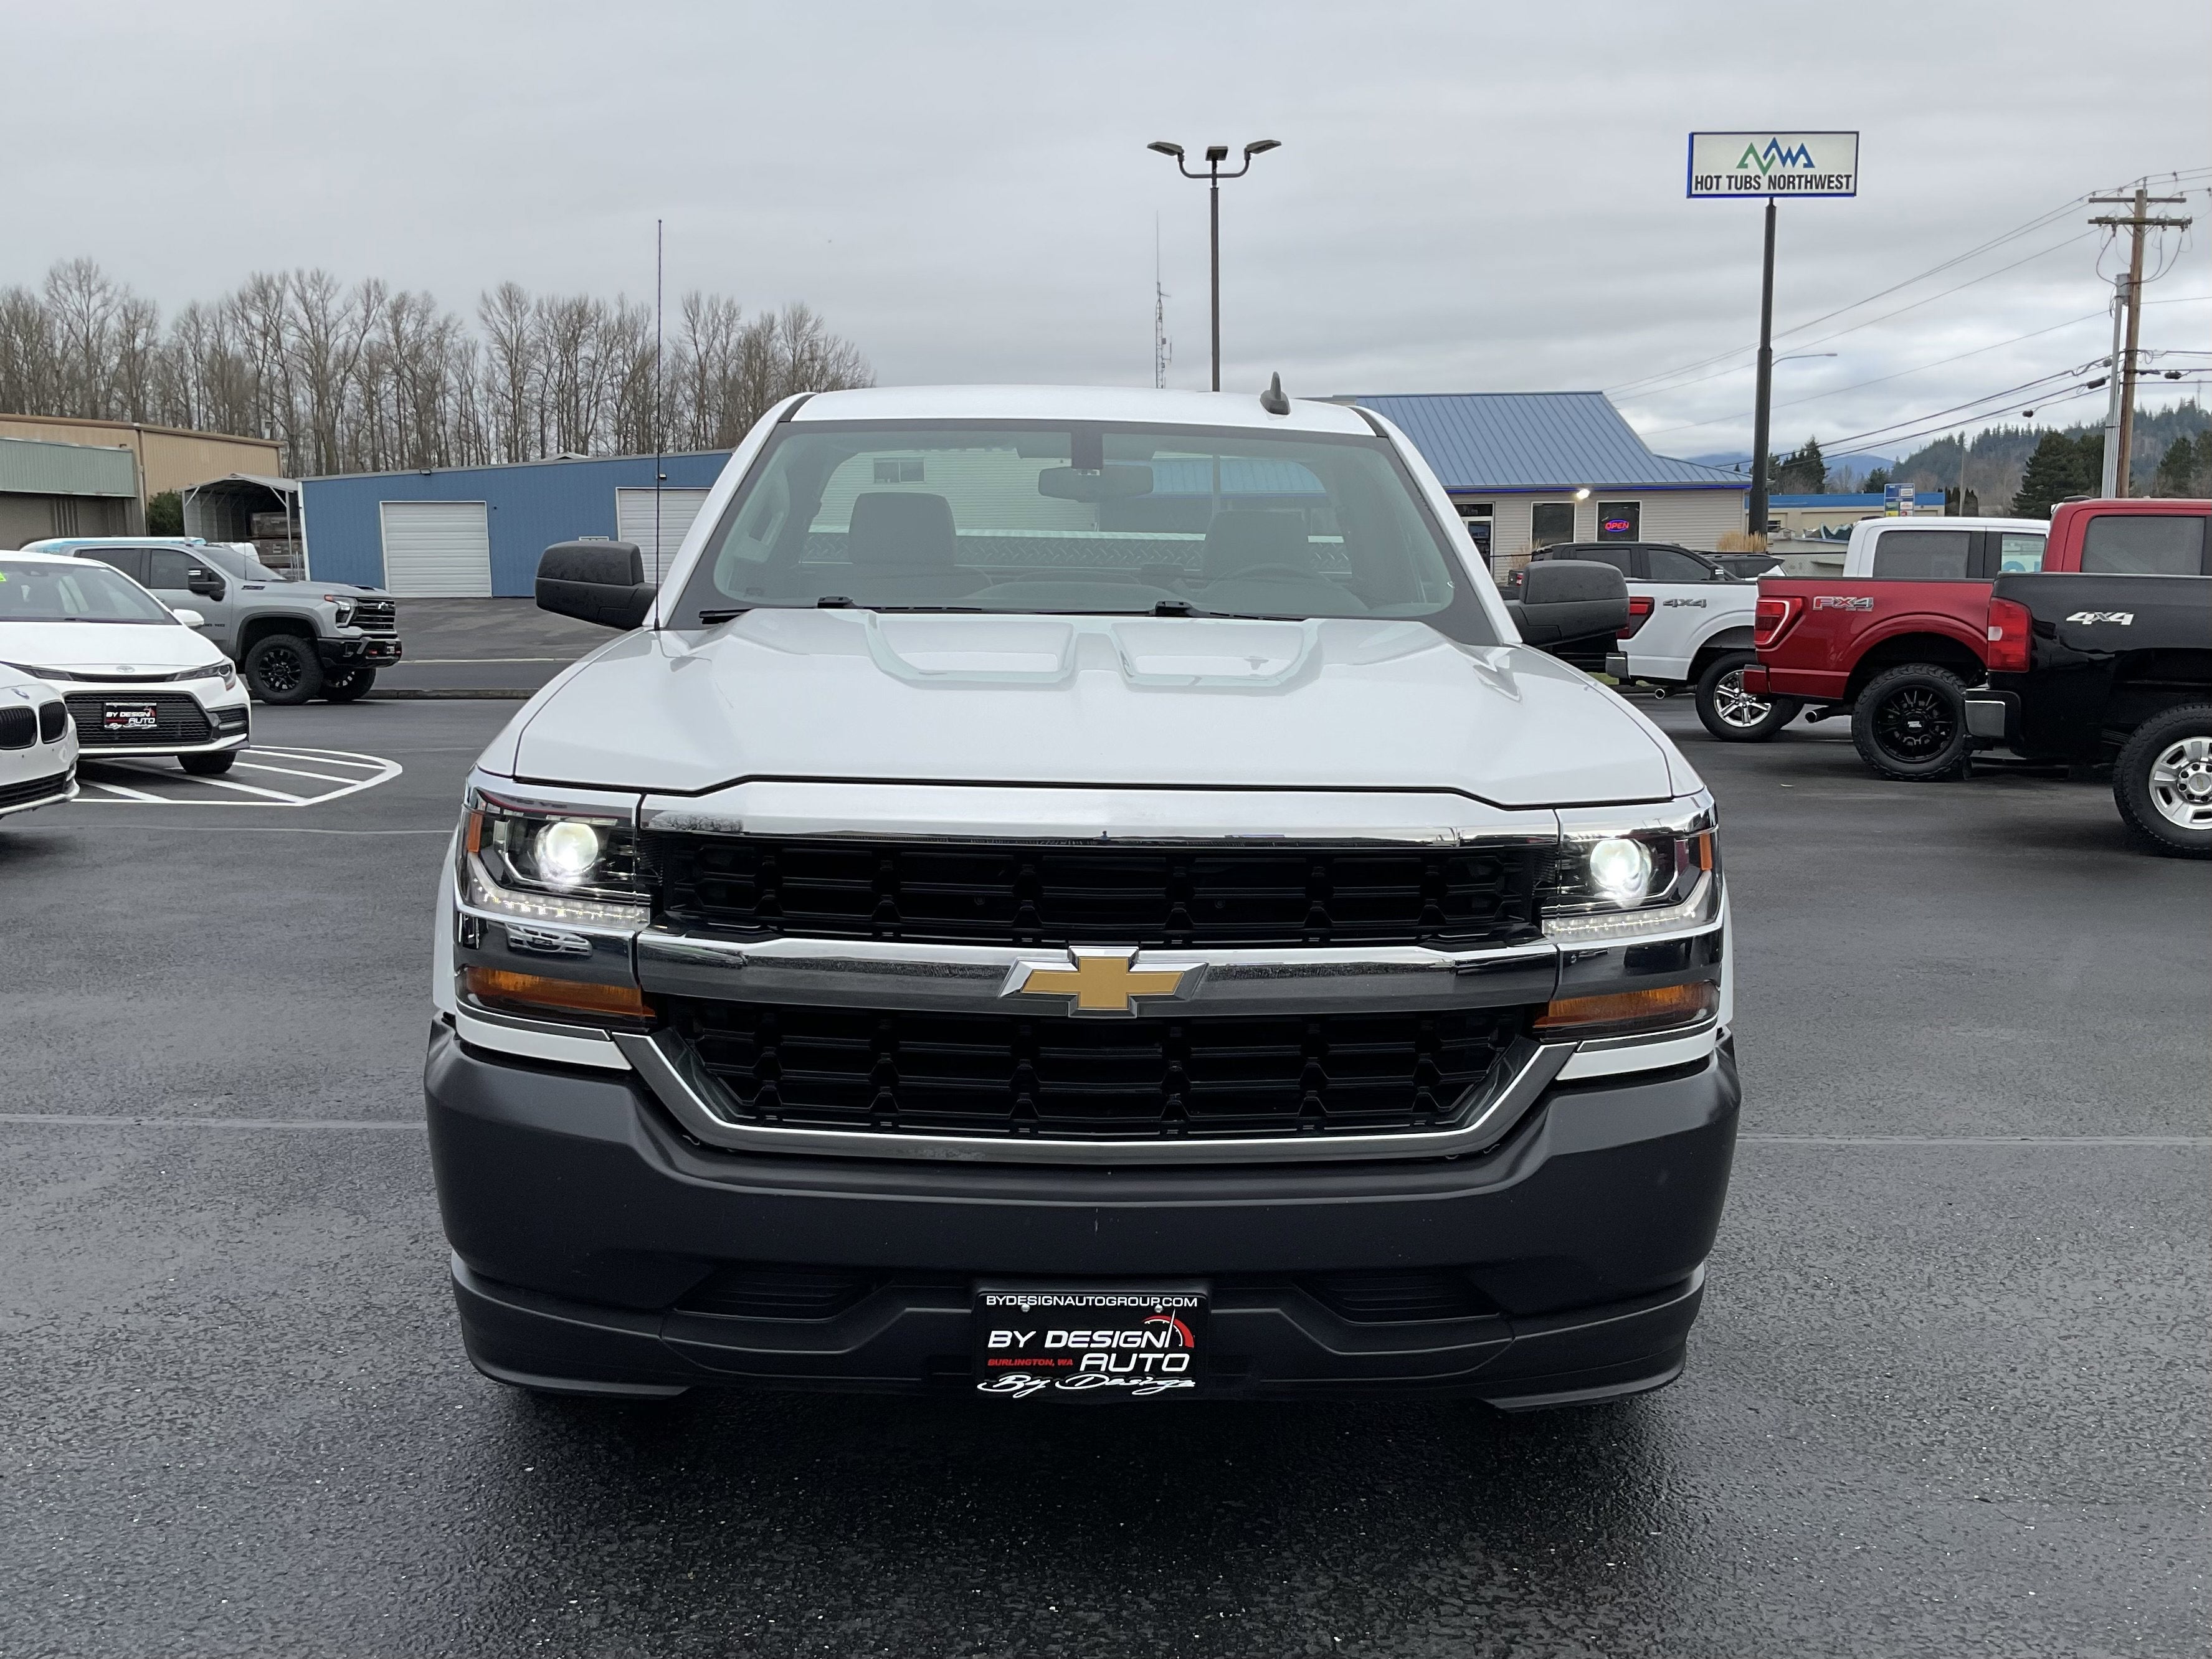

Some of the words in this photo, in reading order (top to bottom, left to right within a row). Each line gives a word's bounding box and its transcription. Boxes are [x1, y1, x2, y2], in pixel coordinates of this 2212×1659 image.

[1694, 175, 1722, 191] HOT
[1726, 175, 1761, 191] TUBS
[1768, 174, 1853, 190] NORTHWEST
[1605, 521, 1630, 530] OPEN
[1813, 596, 1874, 611] FX4
[986, 1295, 1198, 1308] BYDESIGNAUTOGROUP.COM
[987, 1331, 1037, 1348] BY
[1044, 1331, 1167, 1348] DESIGN
[987, 1358, 1055, 1367] BURLINGTON,
[1057, 1358, 1073, 1366] WA
[1079, 1352, 1190, 1372] AUTO
